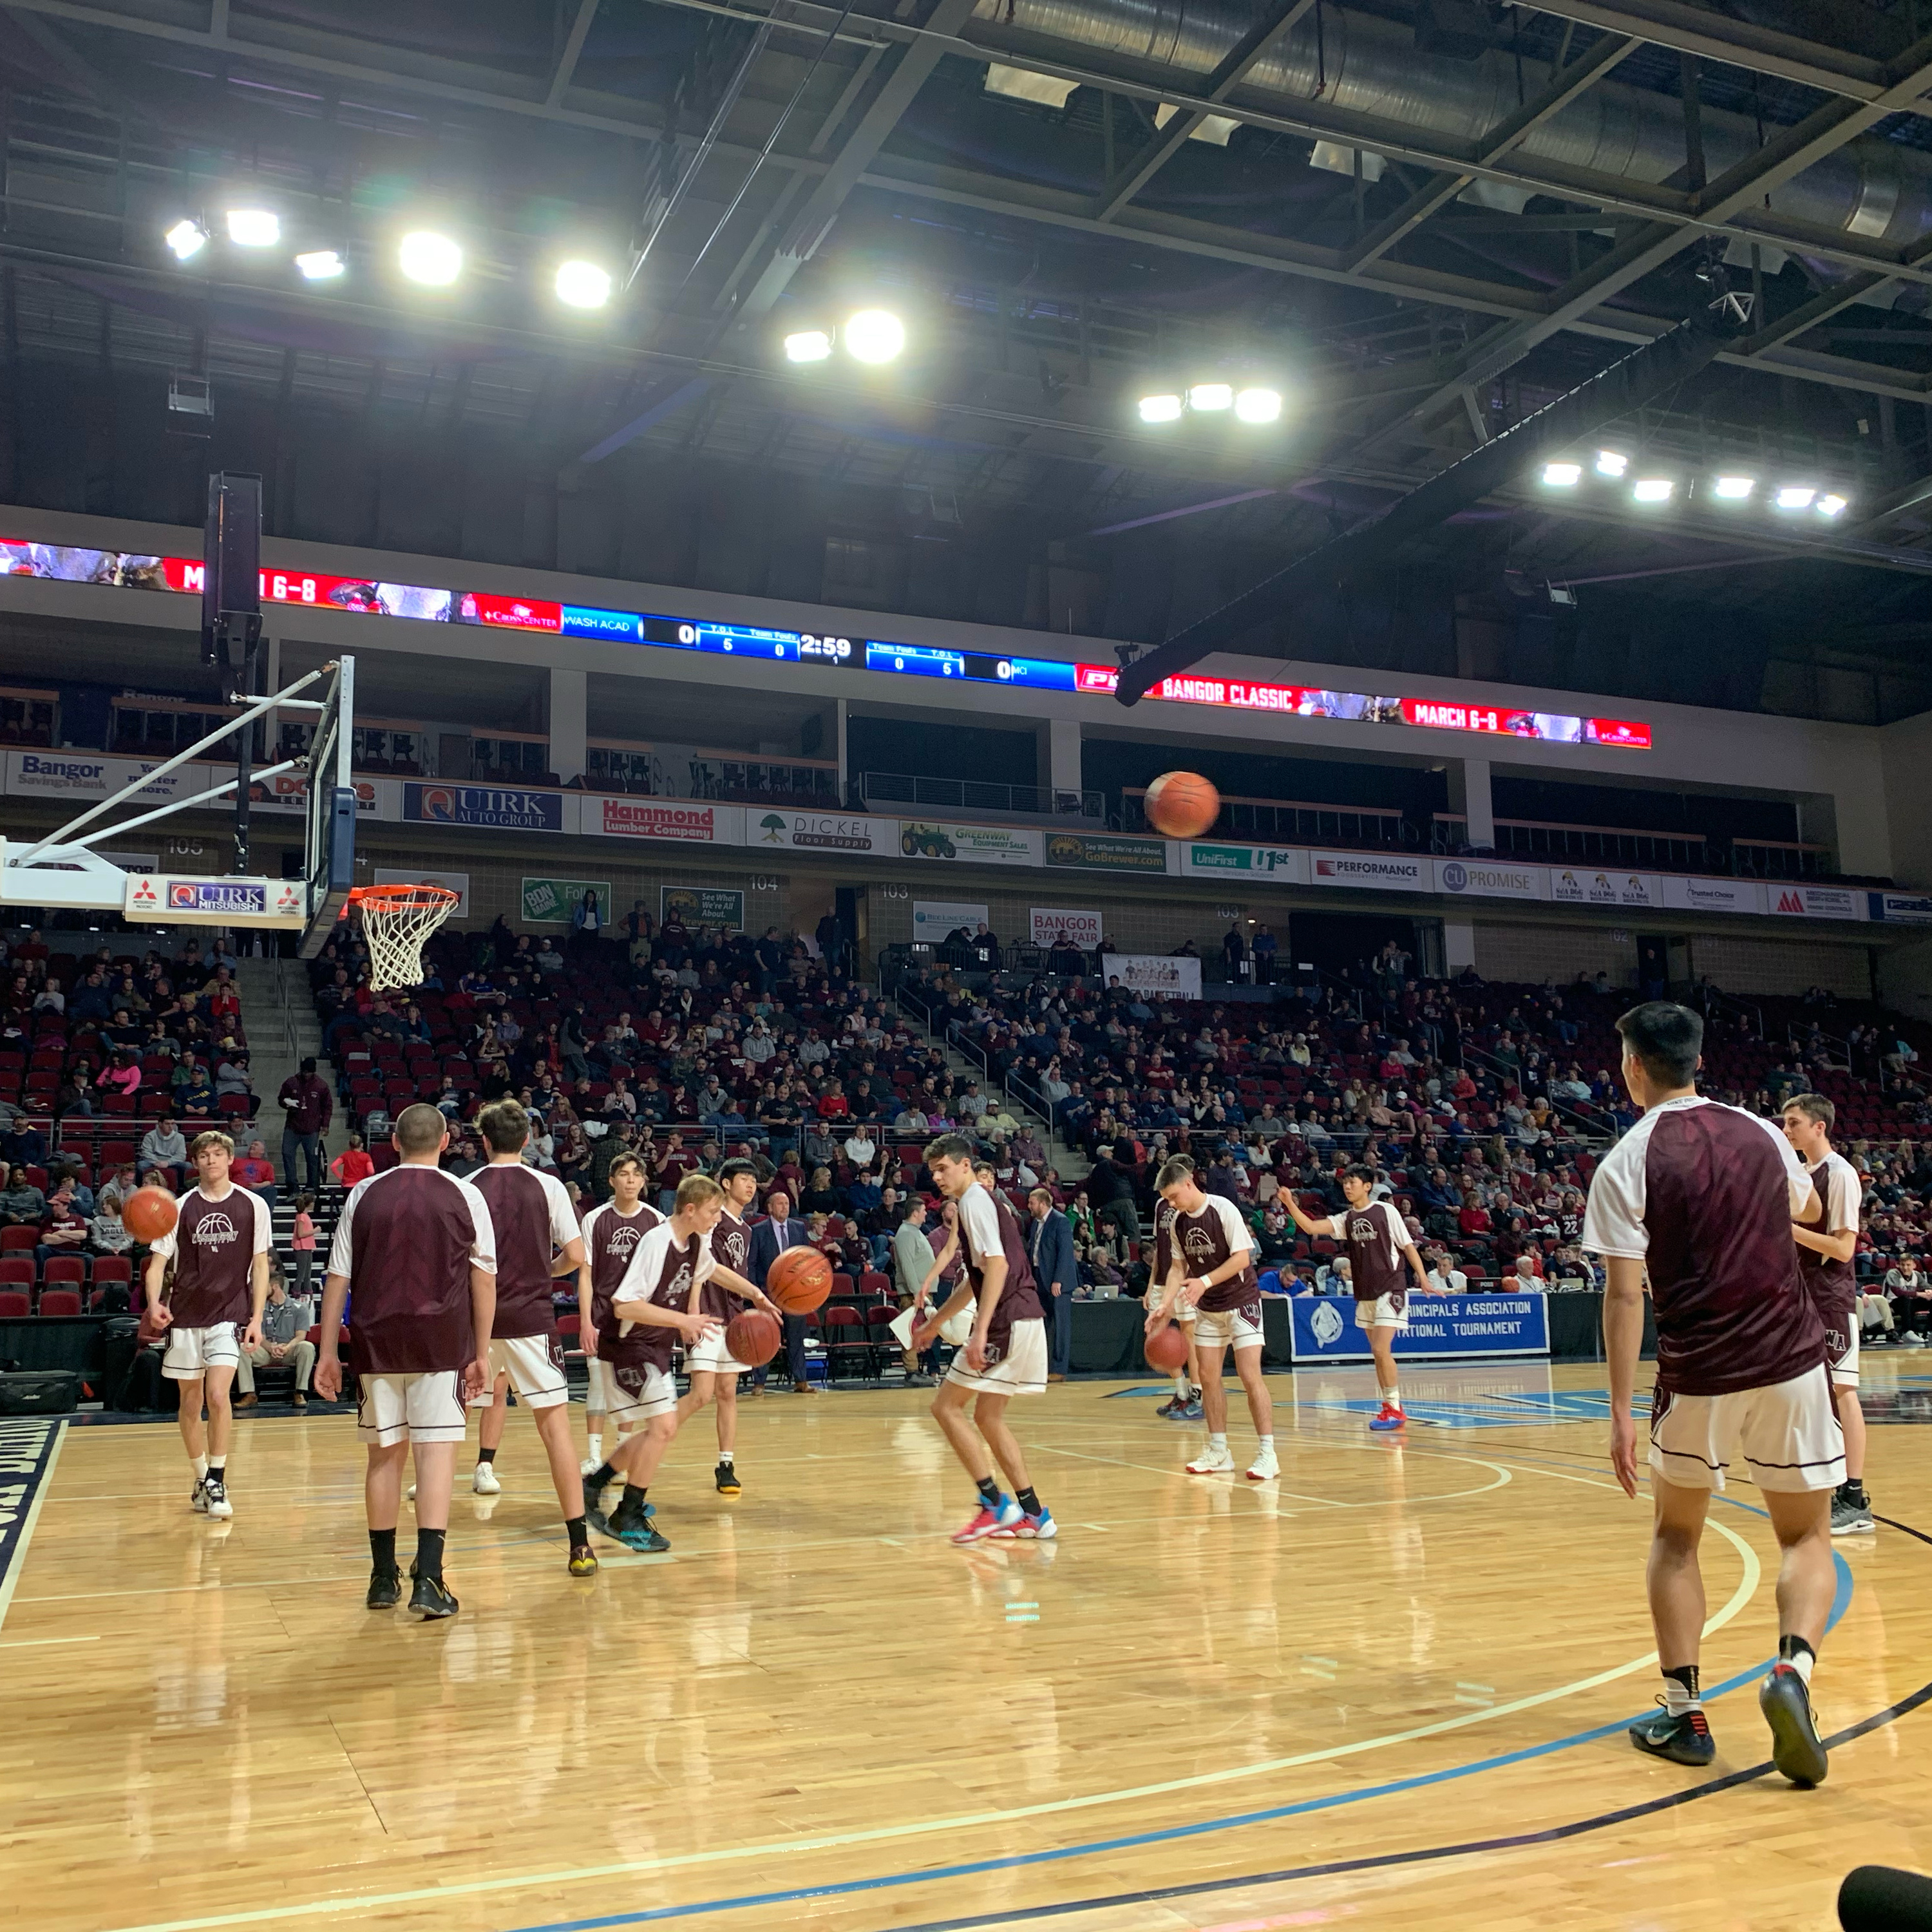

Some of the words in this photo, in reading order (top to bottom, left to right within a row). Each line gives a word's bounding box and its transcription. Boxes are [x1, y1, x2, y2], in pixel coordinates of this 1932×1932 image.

[273, 576, 316, 601] 6-8
[523, 616, 556, 627] CENTER
[564, 616, 597, 628] WASH
[600, 620, 630, 632] ACAD
[679, 625, 694, 643] 0
[749, 629, 773, 638] Team
[775, 631, 797, 640] Fouls
[723, 638, 733, 650] 5
[775, 644, 784, 656] 0
[800, 634, 851, 657] 2:59
[873, 643, 895, 651] Team
[896, 646, 916, 654] Fouls
[833, 656, 838, 665] 1
[895, 658, 904, 670] 0
[943, 662, 951, 675] 5
[997, 661, 1010, 679] 0
[1013, 667, 1027, 676] MCI
[1163, 677, 1224, 702] BANGOR
[1230, 685, 1293, 708] CLASSIC
[1415, 705, 1465, 728] MARCH
[1470, 711, 1497, 730] 6-8
[23, 755, 104, 780] Bangor
[18, 773, 70, 788] Savings
[72, 777, 107, 790] Bank
[424, 788, 545, 820] QUIRK
[603, 800, 714, 825] Hammond
[457, 813, 497, 824] AUTO
[500, 814, 545, 828] GROUP
[795, 817, 872, 837] DICKEL
[606, 821, 650, 835] Lumber
[653, 824, 711, 839] Company
[955, 828, 1012, 841] GREENWAY
[169, 838, 204, 855] 105
[794, 835, 824, 845] Floor
[831, 838, 870, 849] Supply
[972, 838, 1009, 848] EQUIPMENT
[1009, 841, 1028, 849] SALES
[1084, 851, 1163, 867] GoBrewer.com
[1197, 853, 1237, 866] UniFirst
[1337, 861, 1417, 876] PERFORMANCE
[748, 875, 778, 891] 104
[1445, 867, 1464, 885] CU
[1470, 871, 1530, 889] PROMISE
[173, 885, 264, 906] QUIRK
[525, 884, 555, 907] BDN
[565, 886, 604, 900] Follw
[882, 884, 908, 899] 103
[1690, 889, 1713, 898] Trusted
[198, 901, 258, 911] MITSUBISHI
[1215, 905, 1239, 918] 103
[1034, 916, 1097, 931] BANGOR
[1035, 931, 1061, 940] STAT
[1072, 933, 1098, 942] FAIR
[1564, 1220, 1578, 1235] 22
[1408, 1302, 1461, 1318] RINCIPALS'
[1466, 1301, 1531, 1316] ASSOCIATION
[1396, 1324, 1447, 1338] TATIONAL
[1452, 1321, 1522, 1336] TOURNAMENT
